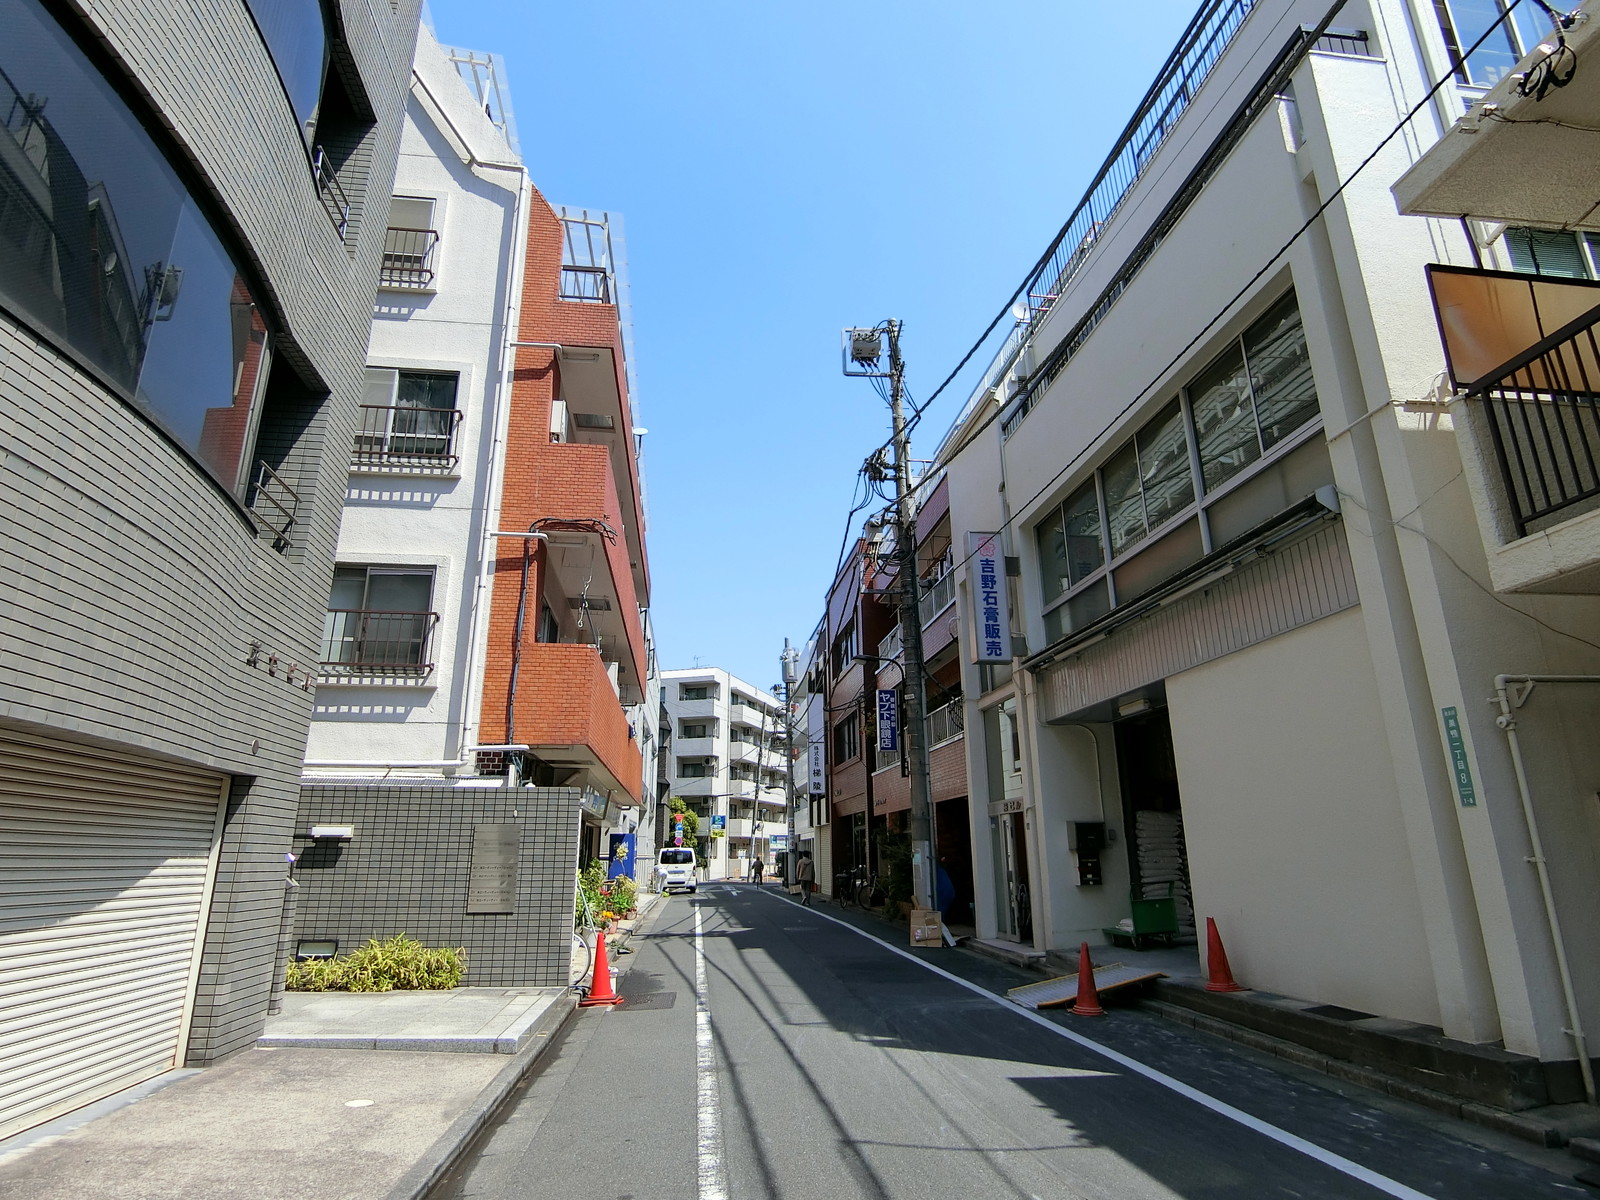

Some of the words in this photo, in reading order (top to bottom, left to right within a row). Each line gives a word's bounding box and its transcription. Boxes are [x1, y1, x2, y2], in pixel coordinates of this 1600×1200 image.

[980, 558, 1003, 657] 吉野石膏販売
[879, 692, 892, 748] ヤブ下眼鏡店
